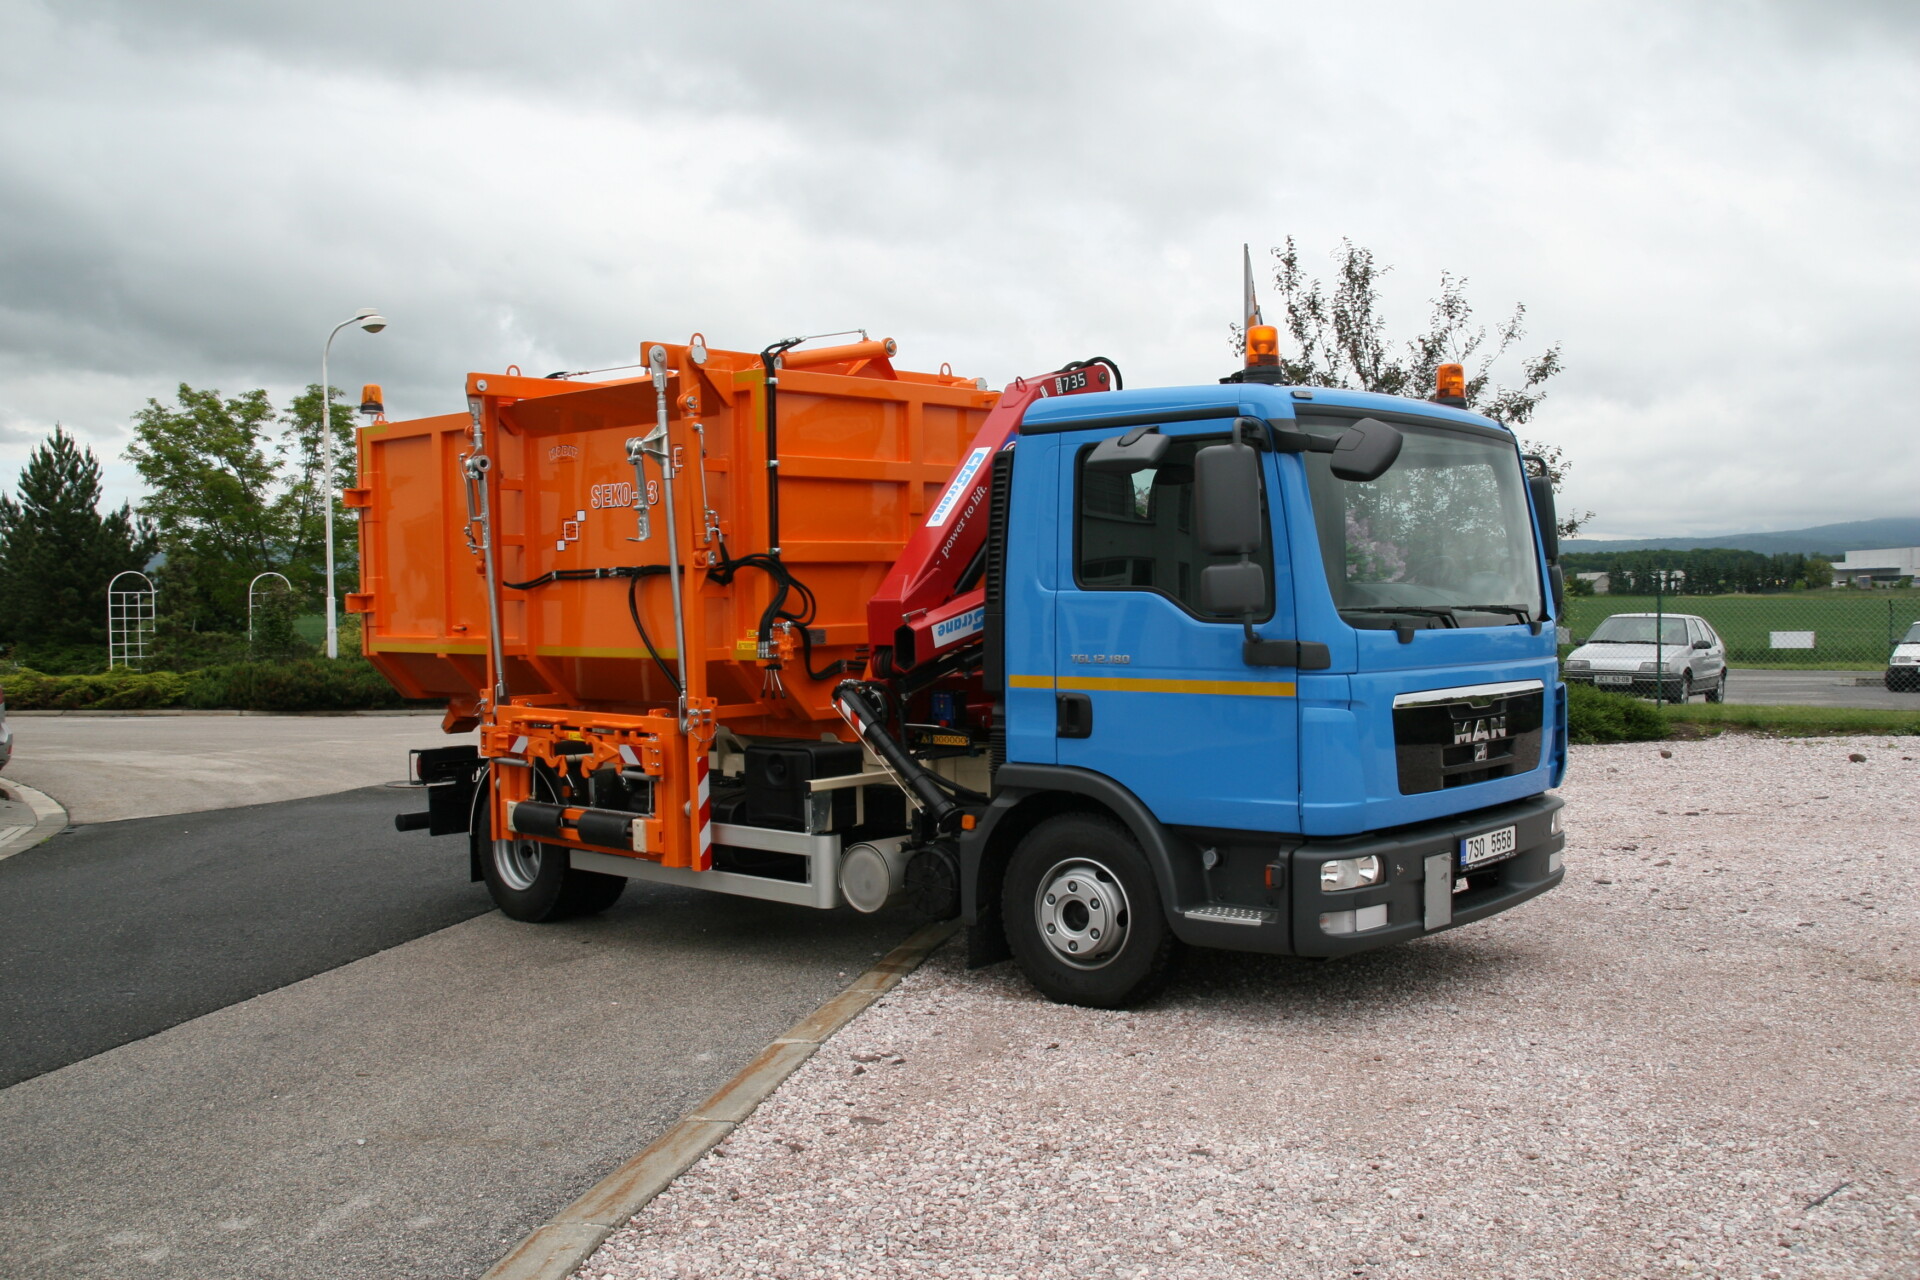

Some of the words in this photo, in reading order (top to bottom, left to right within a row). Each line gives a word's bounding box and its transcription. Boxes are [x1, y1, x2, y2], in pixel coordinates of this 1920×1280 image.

[1063, 373, 1086, 391] 735
[941, 518, 966, 559] power
[964, 505, 974, 519] to
[971, 485, 988, 506] lift.
[1071, 654, 1091, 665] TGL
[1453, 716, 1507, 745] MAN
[1491, 830, 1512, 853] 5558
